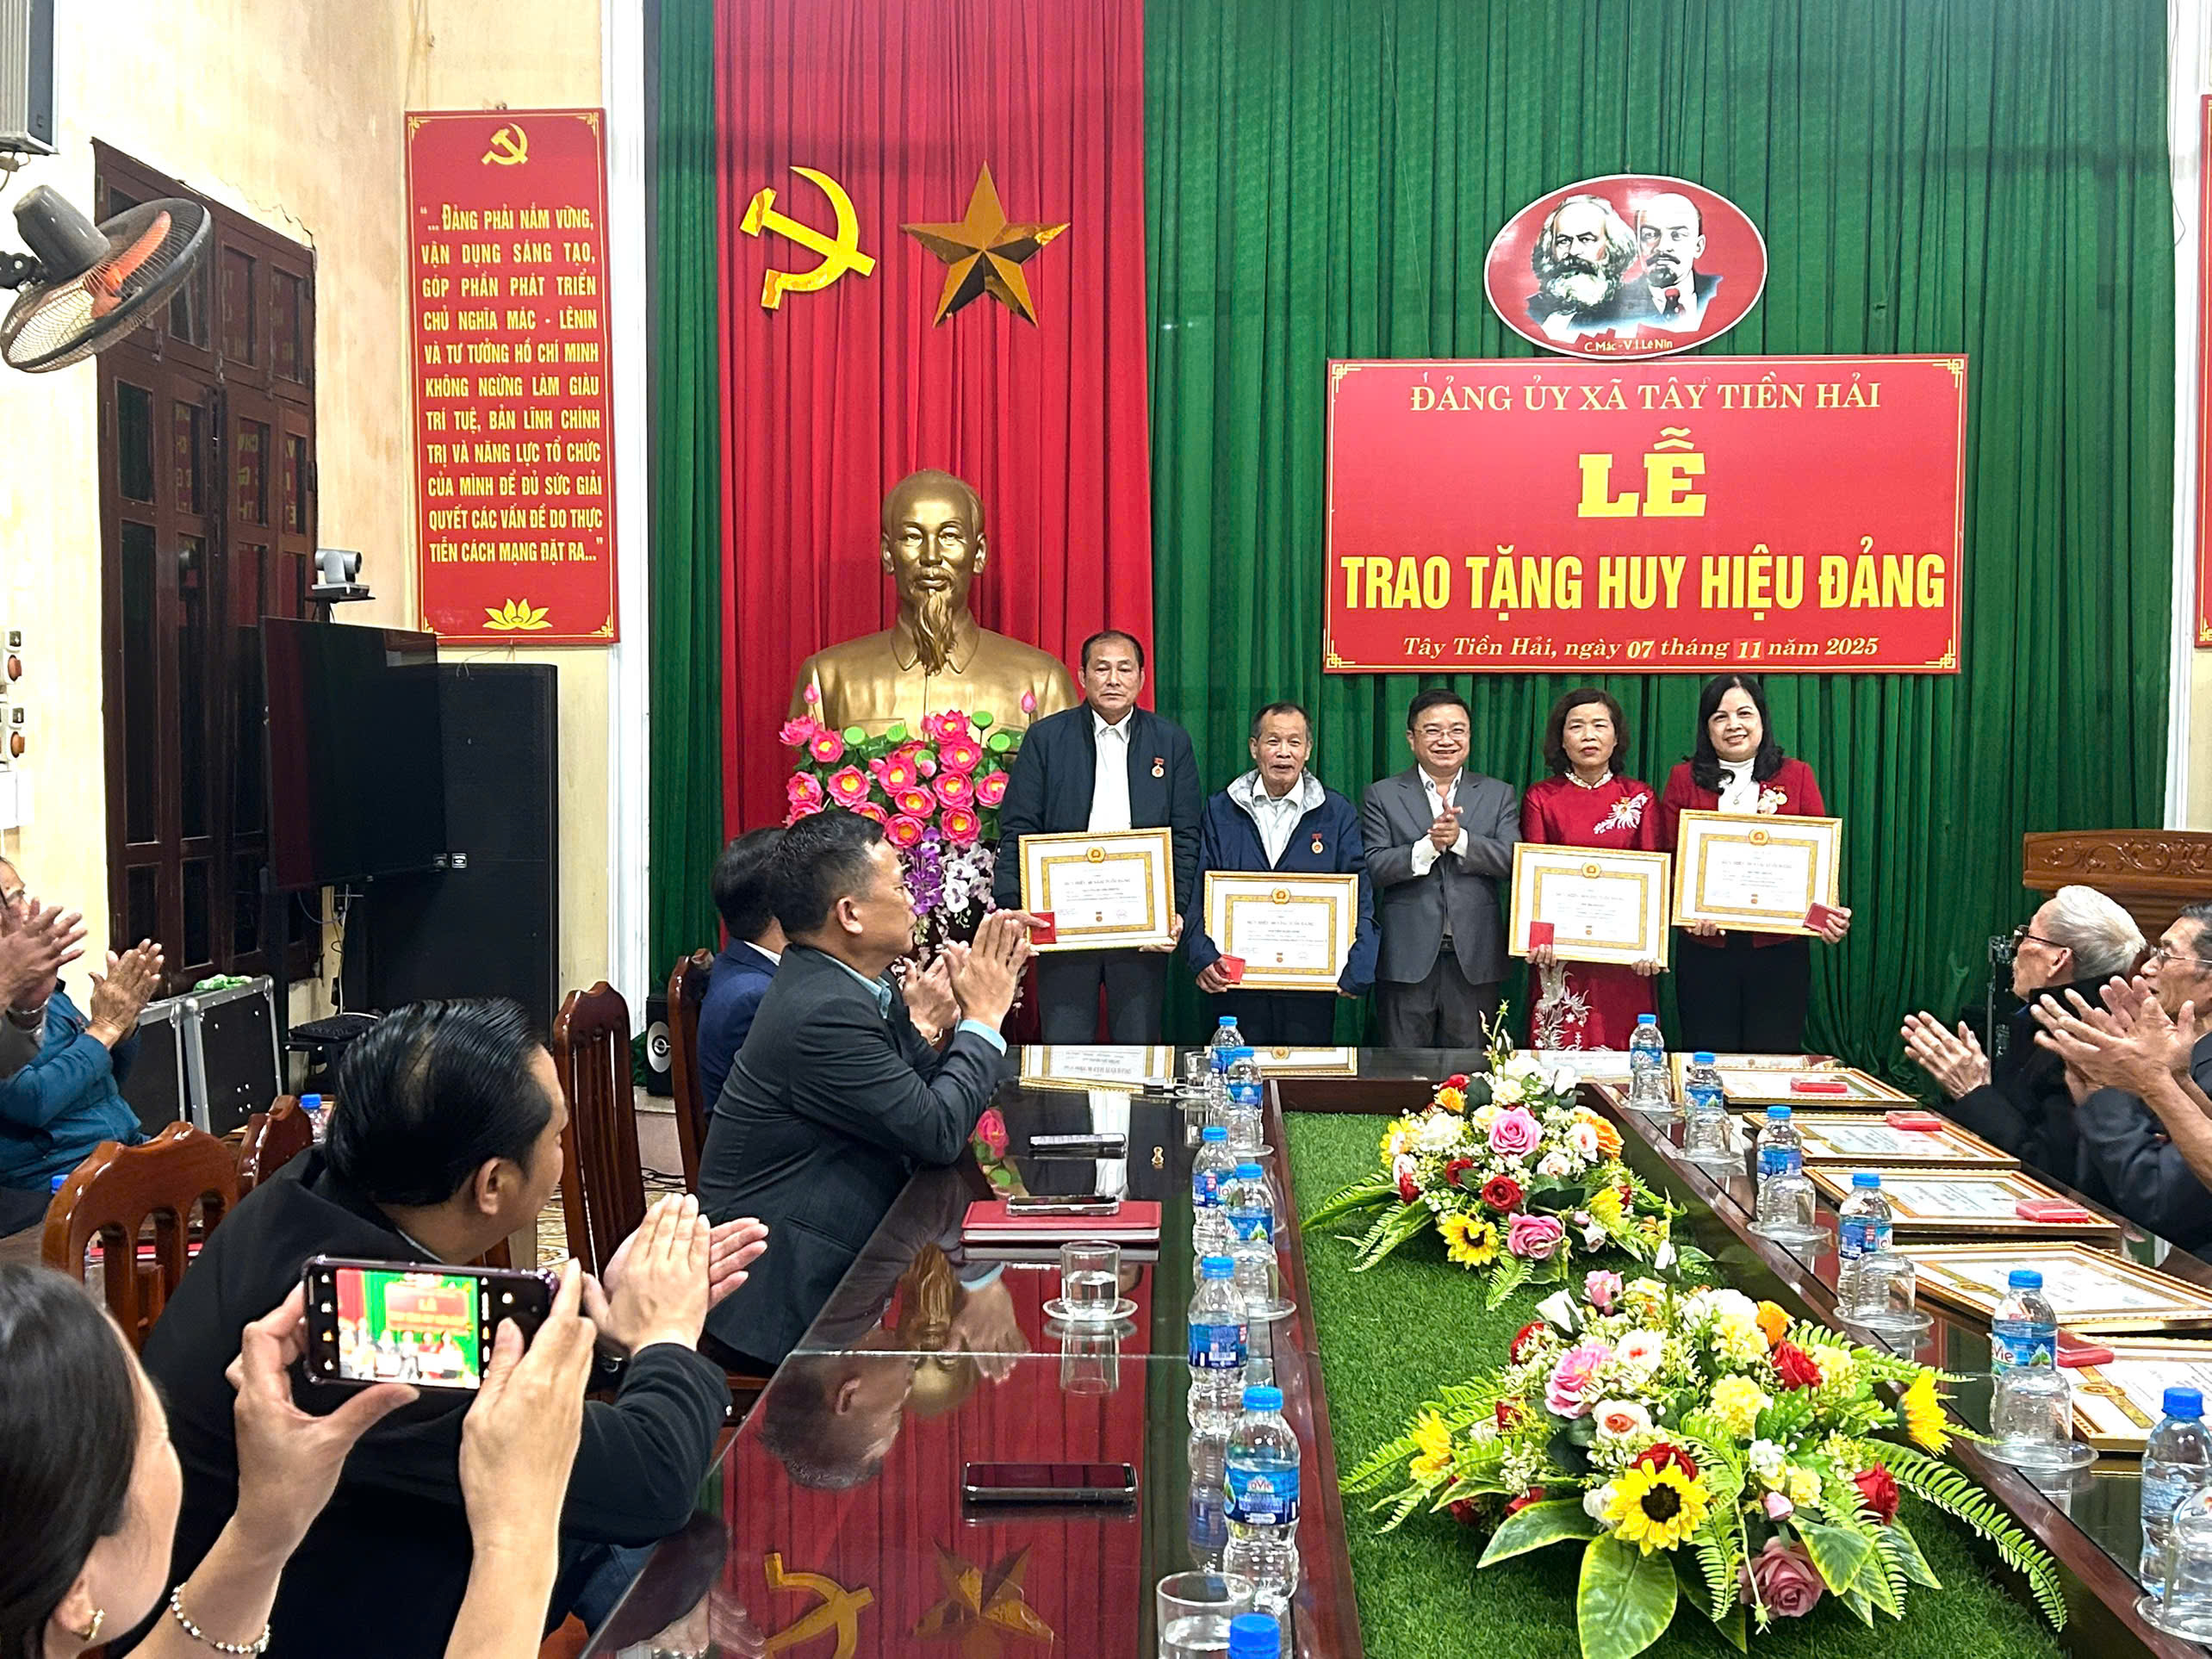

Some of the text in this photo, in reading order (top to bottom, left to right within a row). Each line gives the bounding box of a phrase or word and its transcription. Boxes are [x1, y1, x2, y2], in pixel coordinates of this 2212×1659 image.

[483, 203, 514, 230] PHẢI
[519, 202, 550, 229] NẮM
[556, 205, 594, 230] VỮNG,
[421, 239, 595, 268] VẬN DỤNG SÁNG TẠO,
[422, 268, 596, 297] GÓP PHẦN PHÁT TRIỂN
[423, 304, 450, 331] CHỦ
[458, 307, 498, 331] NGHĨA
[506, 306, 536, 330] MÁC
[559, 305, 598, 329] LÊNIN
[424, 337, 599, 364] VÀ TƯ TƯỞNG HỒ CHÍ MINH
[426, 371, 600, 397] KHÔNG NGỪNG LÀM GIÀU
[1409, 371, 1881, 411] ĐẢNG ỦY XÃ TÂY TIỀN HẢI
[426, 404, 600, 434] TRÍ TUỆ, BẢN LĨNH CHÍNH
[427, 435, 601, 468] TRỊ VÀ NĂNG LỰC TỔ CHỨC
[428, 469, 602, 496] CỦA MÌNH ĐỂ ĐỦ SỨC GIẢI
[1577, 426, 1707, 518] LỄ
[428, 503, 469, 531] QUYẾT
[471, 505, 497, 529] CÁC
[500, 503, 526, 529] VẤN
[550, 509, 566, 528] DO
[570, 506, 603, 532] THỰC
[429, 536, 458, 562] TIỄN
[461, 538, 495, 562] CÁCH
[499, 543, 537, 566] MẠNG
[540, 538, 565, 566] ĐẶT
[1340, 536, 1945, 621] TRAO TẶNG HUY HIỆU ĐẢNG
[1403, 635, 1880, 660] Tây Tiền Hải, ngày 07 tháng 11 năm 2025
